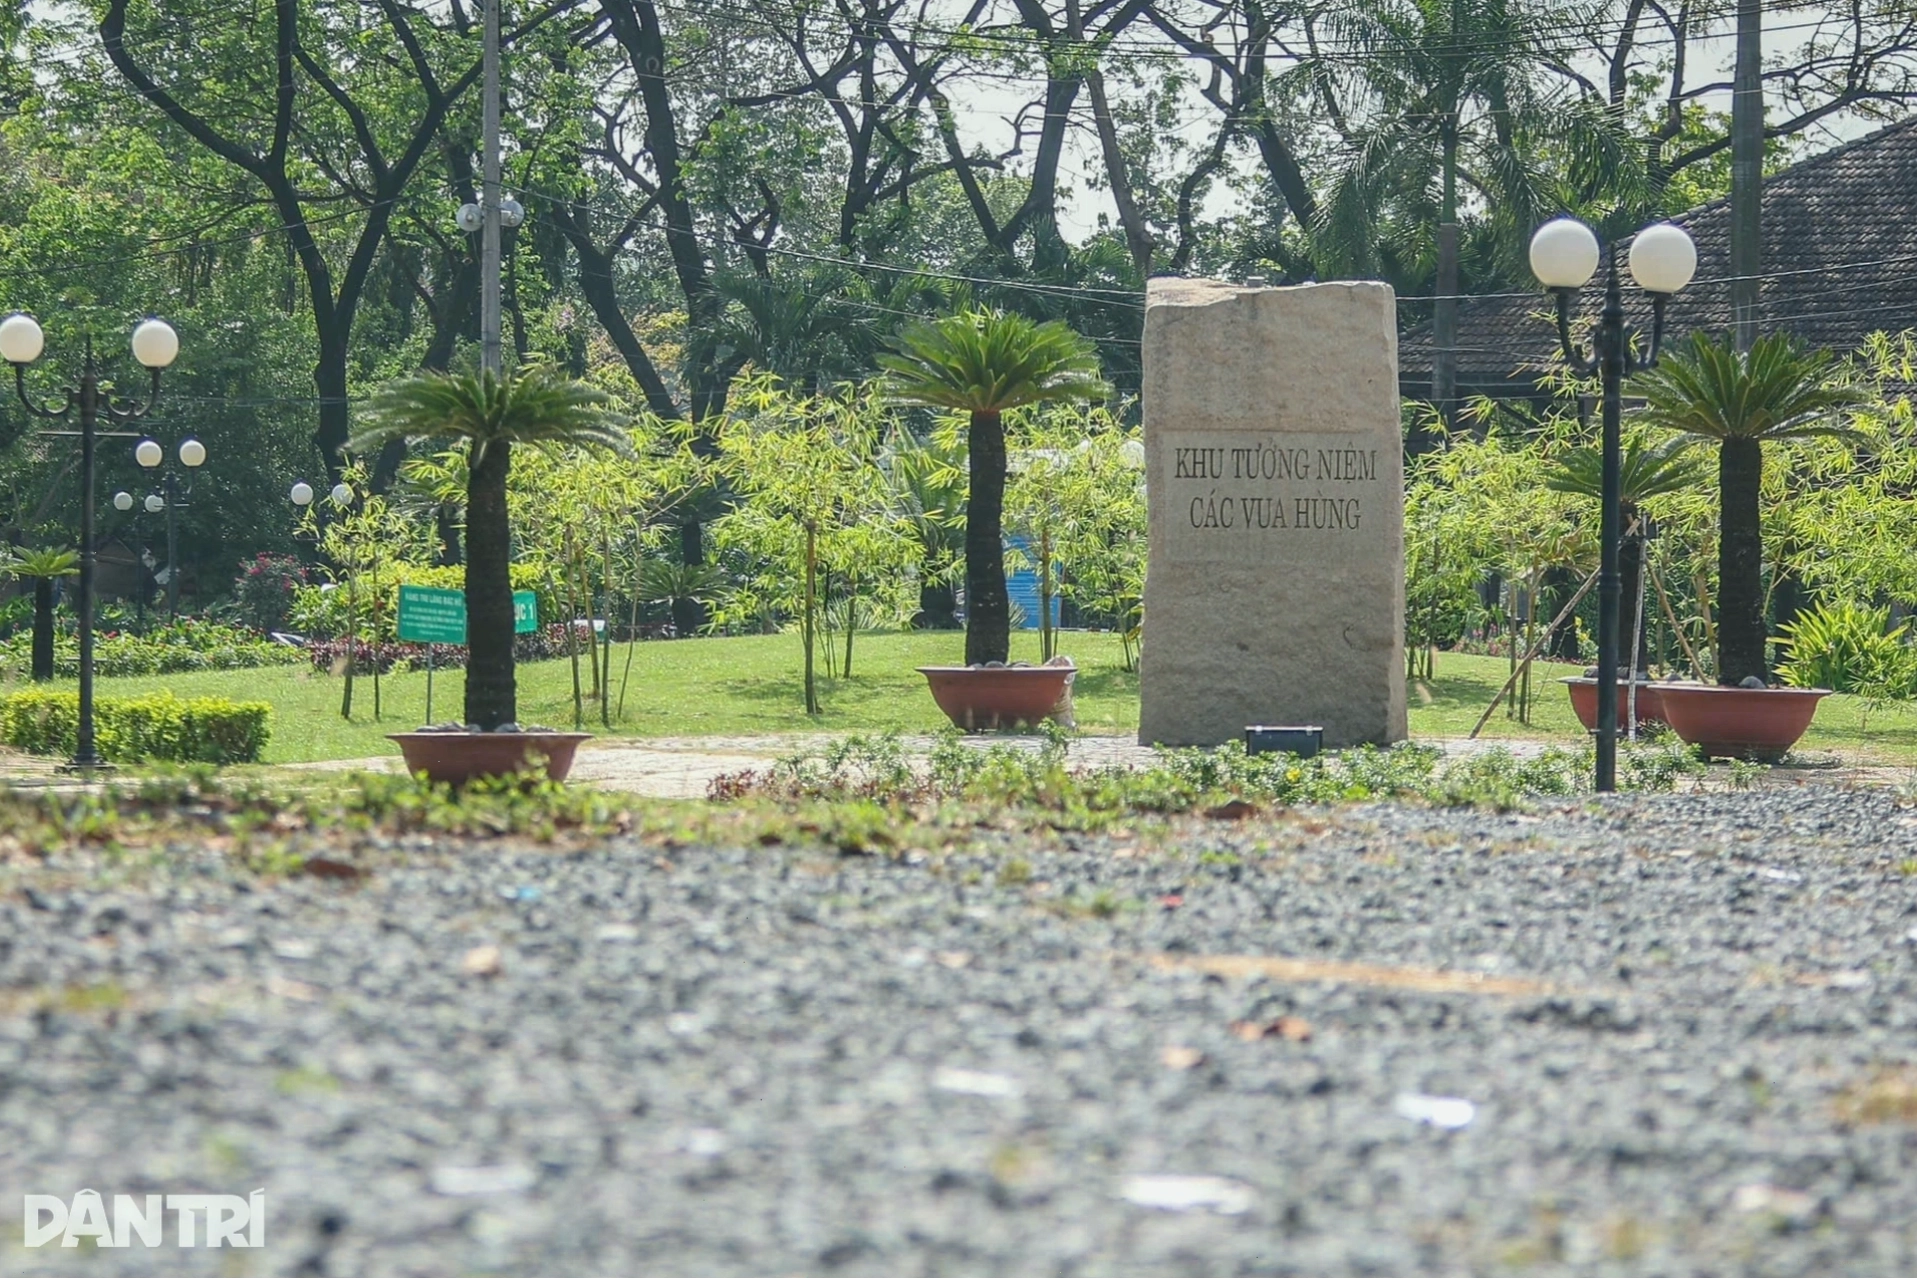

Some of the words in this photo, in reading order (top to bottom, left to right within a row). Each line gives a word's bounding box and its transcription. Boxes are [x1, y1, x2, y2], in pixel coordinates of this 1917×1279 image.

[1174, 447, 1224, 479] KHU
[1231, 437, 1310, 480] TƯỞNG
[1316, 441, 1378, 484] NIỆM
[1190, 489, 1234, 529] CÁC
[1240, 497, 1288, 529] VUA
[1294, 490, 1361, 530] HÙNG
